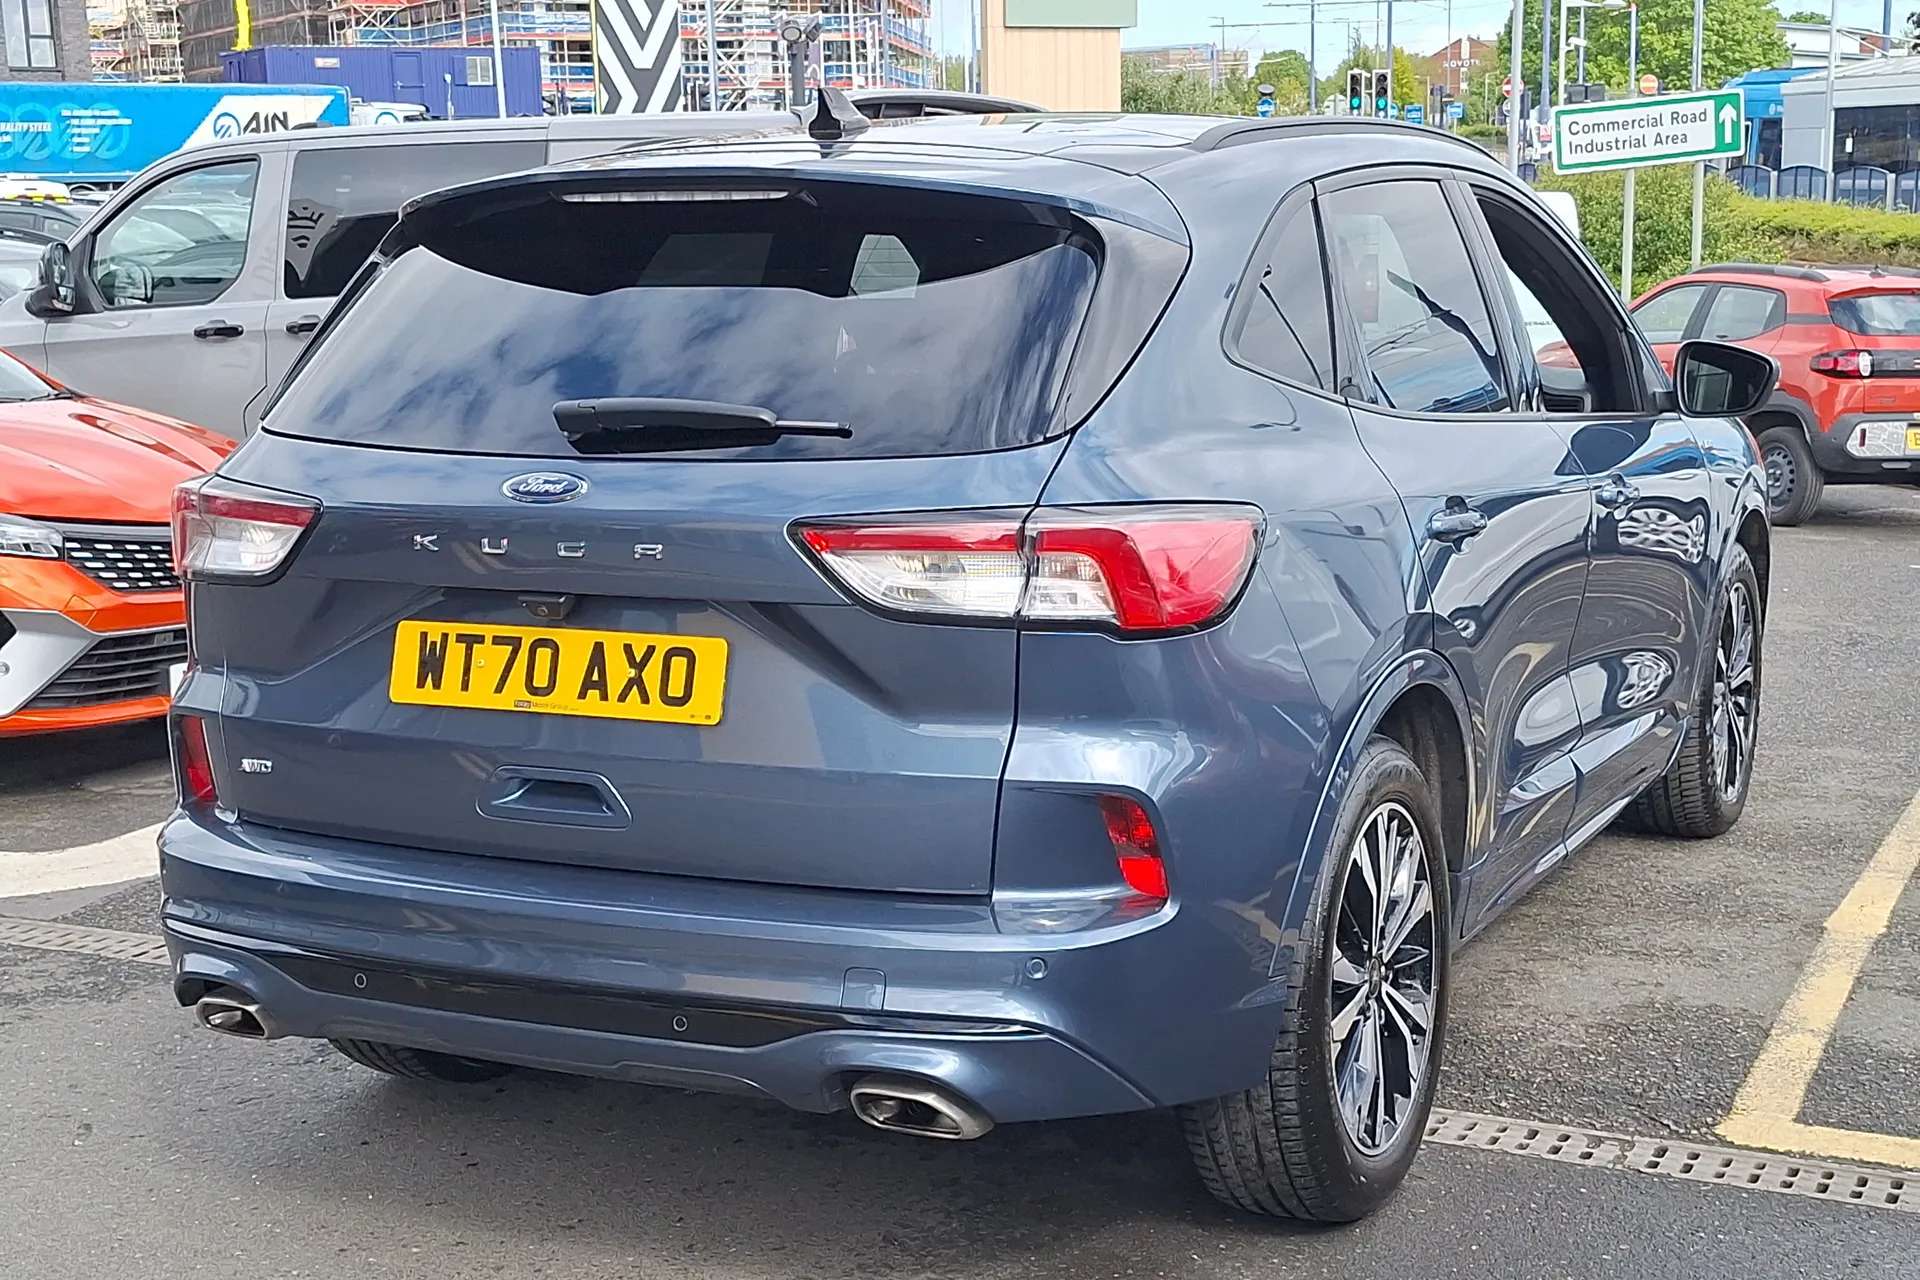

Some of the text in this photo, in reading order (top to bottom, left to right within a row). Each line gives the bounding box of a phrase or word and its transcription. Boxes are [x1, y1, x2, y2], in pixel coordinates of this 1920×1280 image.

[1568, 108, 1708, 136] Commercial Road
[1568, 131, 1688, 155] Industrial Area
[518, 476, 569, 494] Ford
[412, 533, 664, 561] KUGA
[415, 631, 697, 708] WT70 AXO
